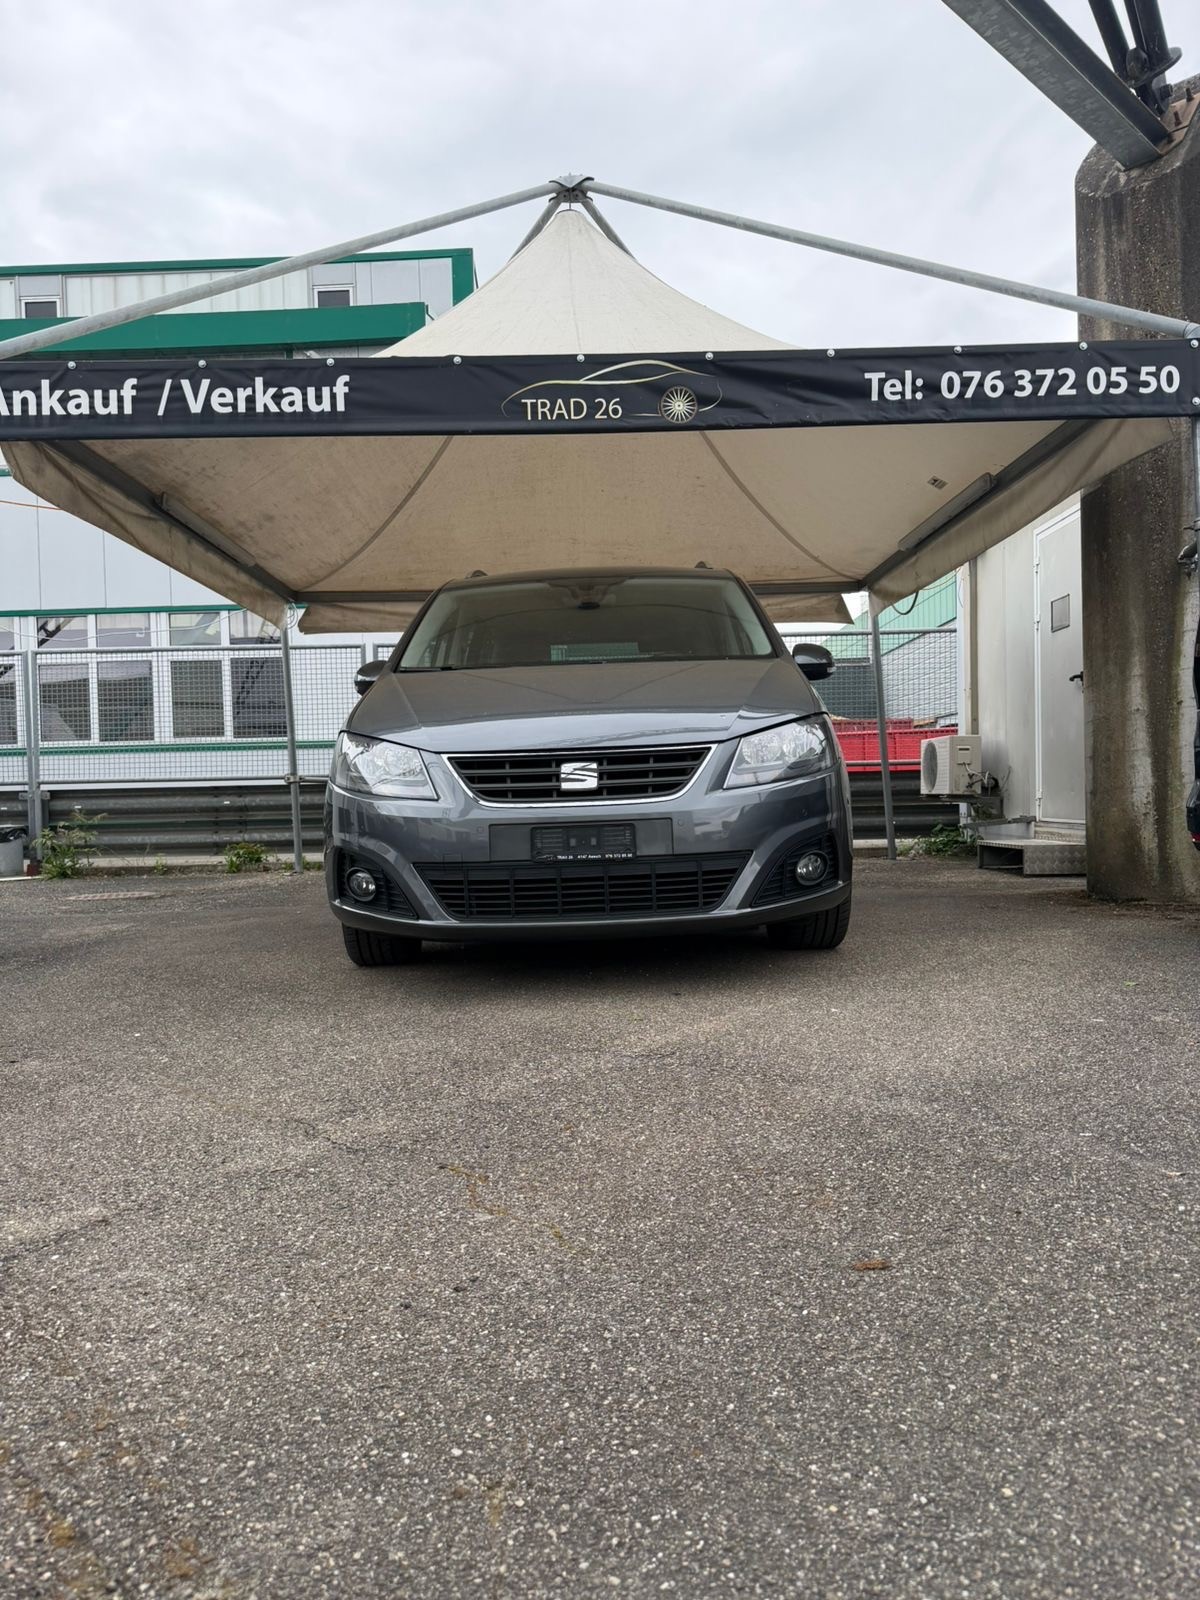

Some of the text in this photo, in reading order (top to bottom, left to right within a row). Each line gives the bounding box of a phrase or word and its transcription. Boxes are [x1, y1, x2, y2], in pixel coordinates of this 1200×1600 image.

[180, 375, 350, 414] Verkauf
[864, 365, 1181, 401] Tel: 076 372 05 50
[521, 397, 623, 421] TRAD 26
